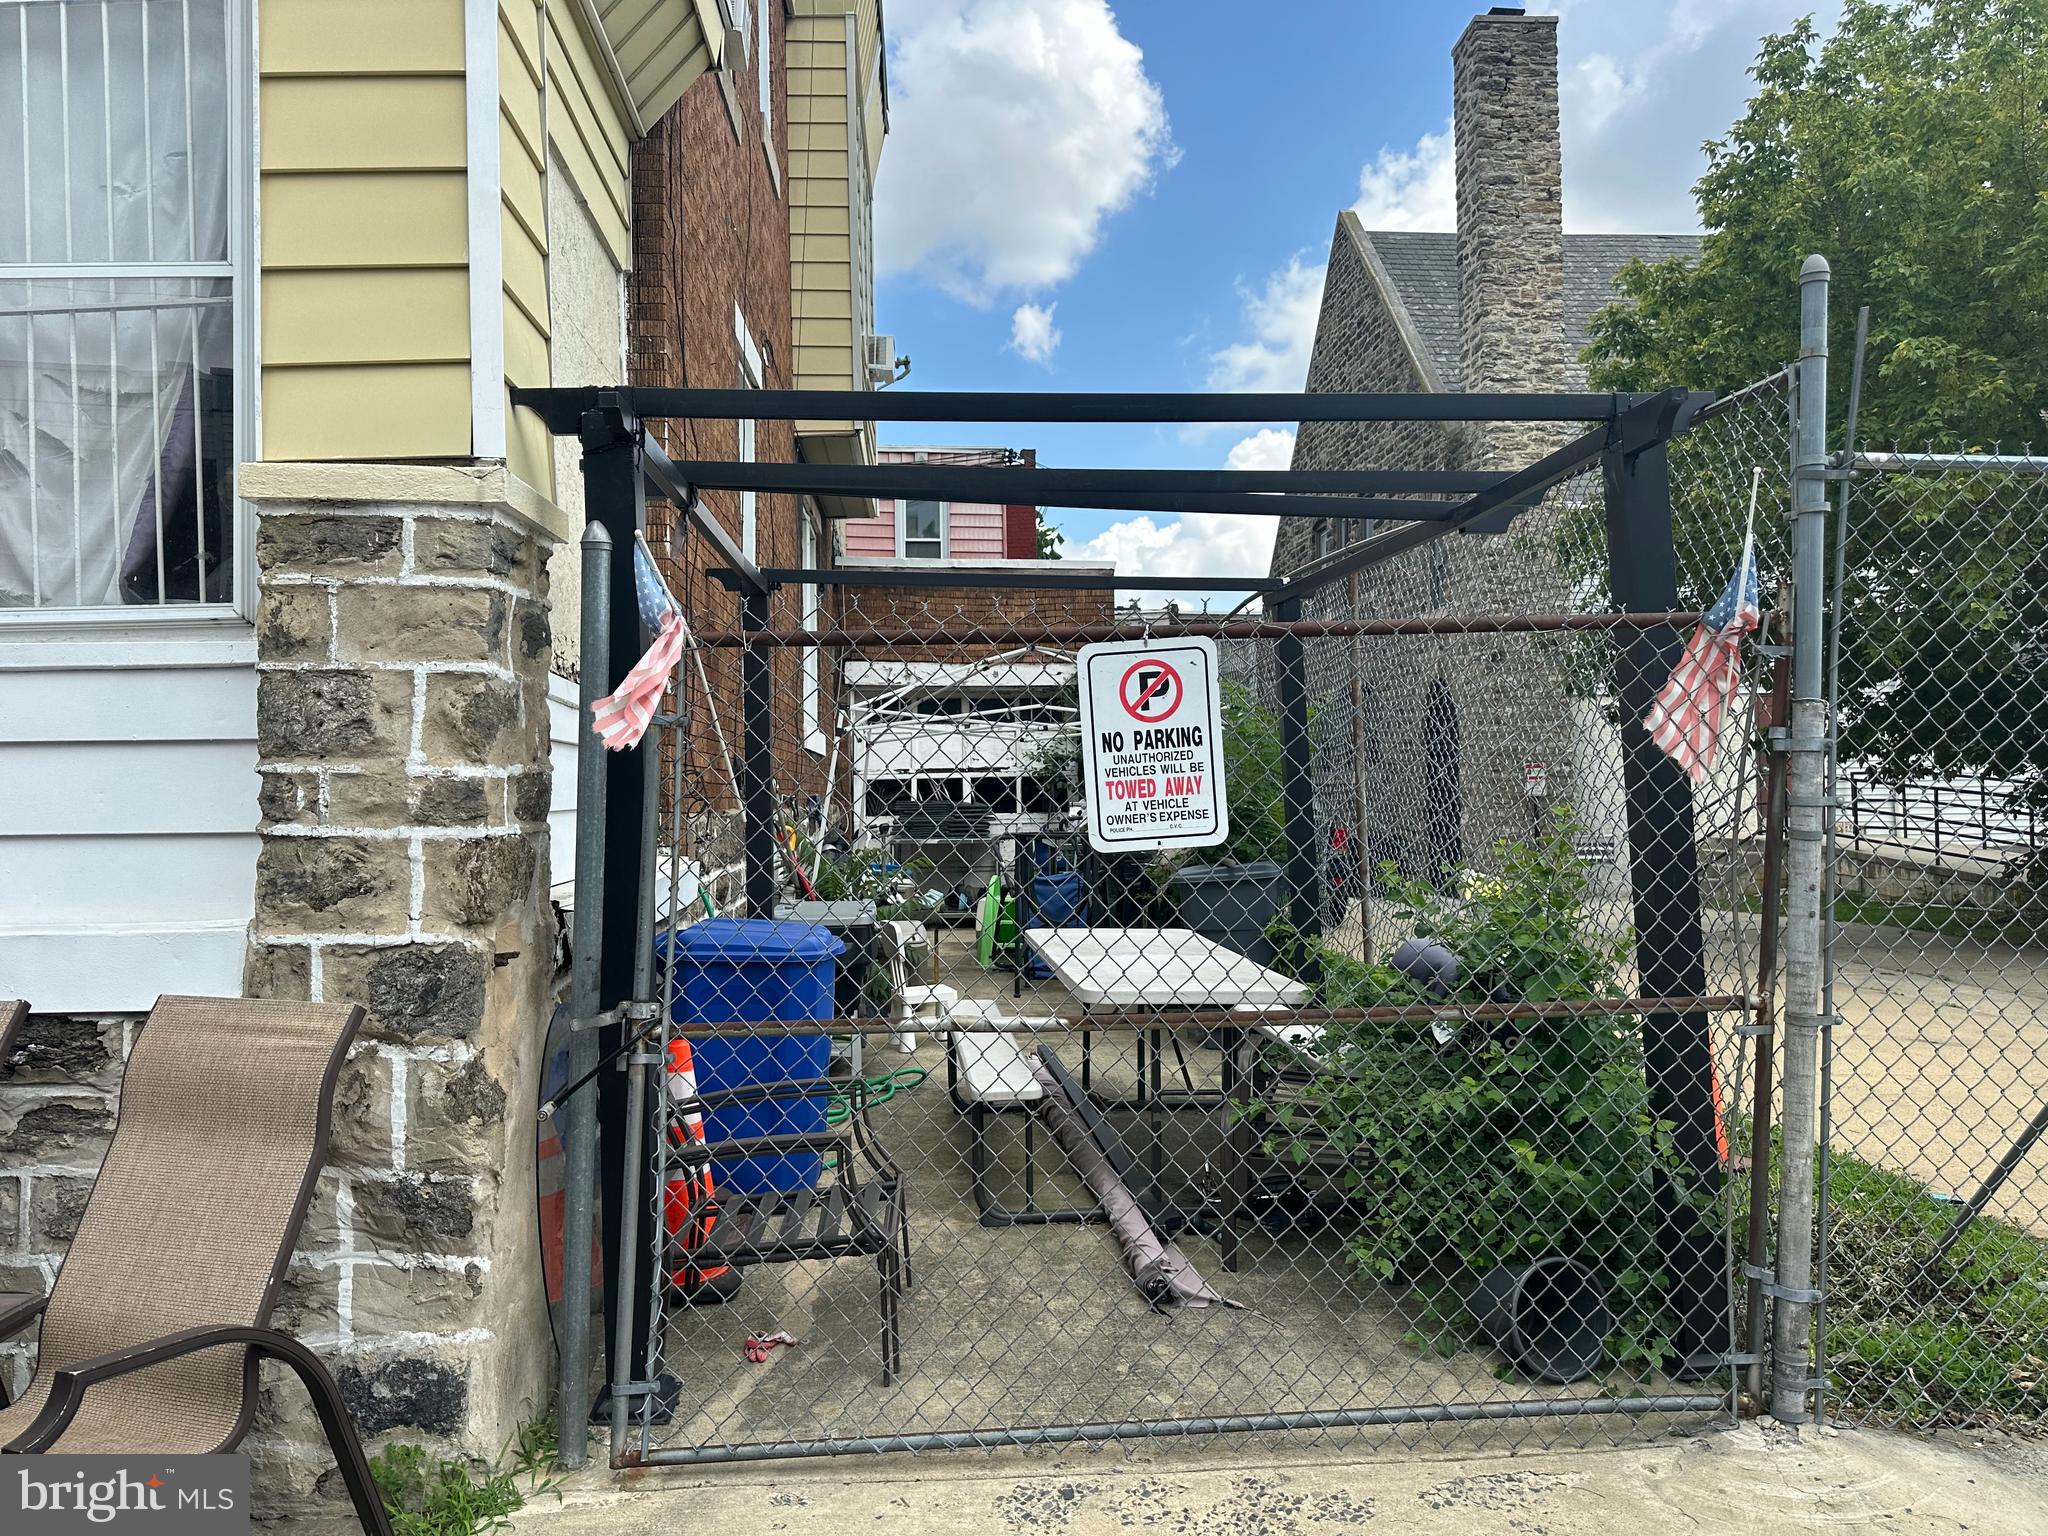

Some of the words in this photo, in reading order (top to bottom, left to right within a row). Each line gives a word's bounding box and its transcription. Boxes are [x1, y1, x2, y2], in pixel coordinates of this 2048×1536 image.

[1102, 731, 1124, 753] NO
[1133, 726, 1203, 750] PARKING
[1113, 750, 1194, 765] UNAUTHORIZED
[1104, 765, 1156, 778] VEHICLES
[1160, 763, 1186, 774] WILL
[1190, 762, 1204, 773] BE
[1105, 778, 1157, 800] TOWED
[1165, 775, 1203, 797] AWAY
[1125, 801, 1138, 812] AT
[1142, 797, 1189, 811] VEHICLE
[1106, 812, 1157, 826] OWNER'S
[1159, 808, 1209, 822] EXPENSE
